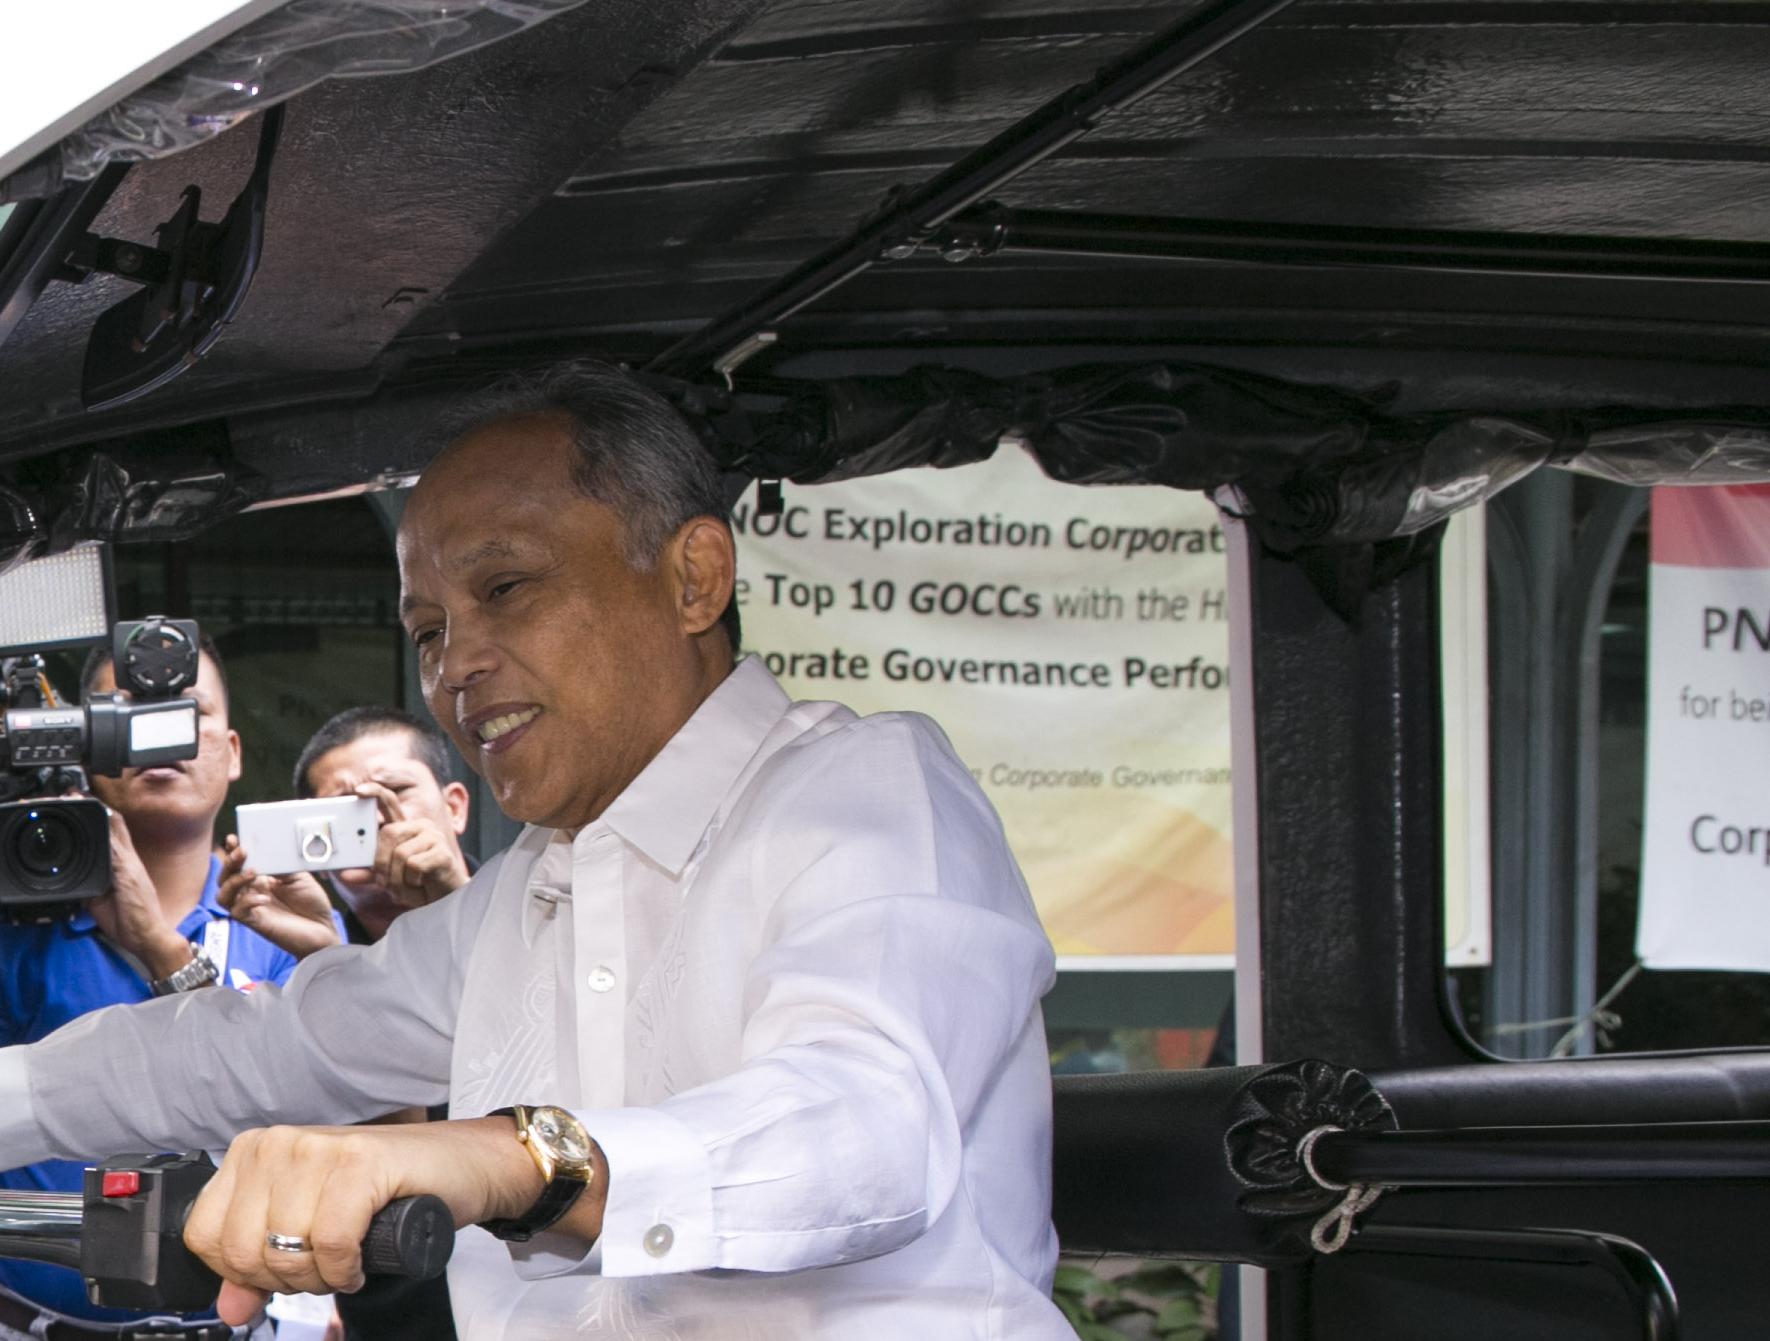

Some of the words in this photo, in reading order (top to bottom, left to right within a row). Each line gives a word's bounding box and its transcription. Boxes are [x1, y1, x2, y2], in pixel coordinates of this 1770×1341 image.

[824, 509, 1052, 550] Exploration
[764, 573, 835, 616] Top
[849, 578, 896, 613] 10
[909, 580, 1041, 618] GOCCs
[1054, 585, 1125, 619] with
[1137, 587, 1190, 622] the
[883, 648, 1112, 688] Governance
[1679, 685, 1722, 718] for
[989, 762, 1104, 791] Corporate
